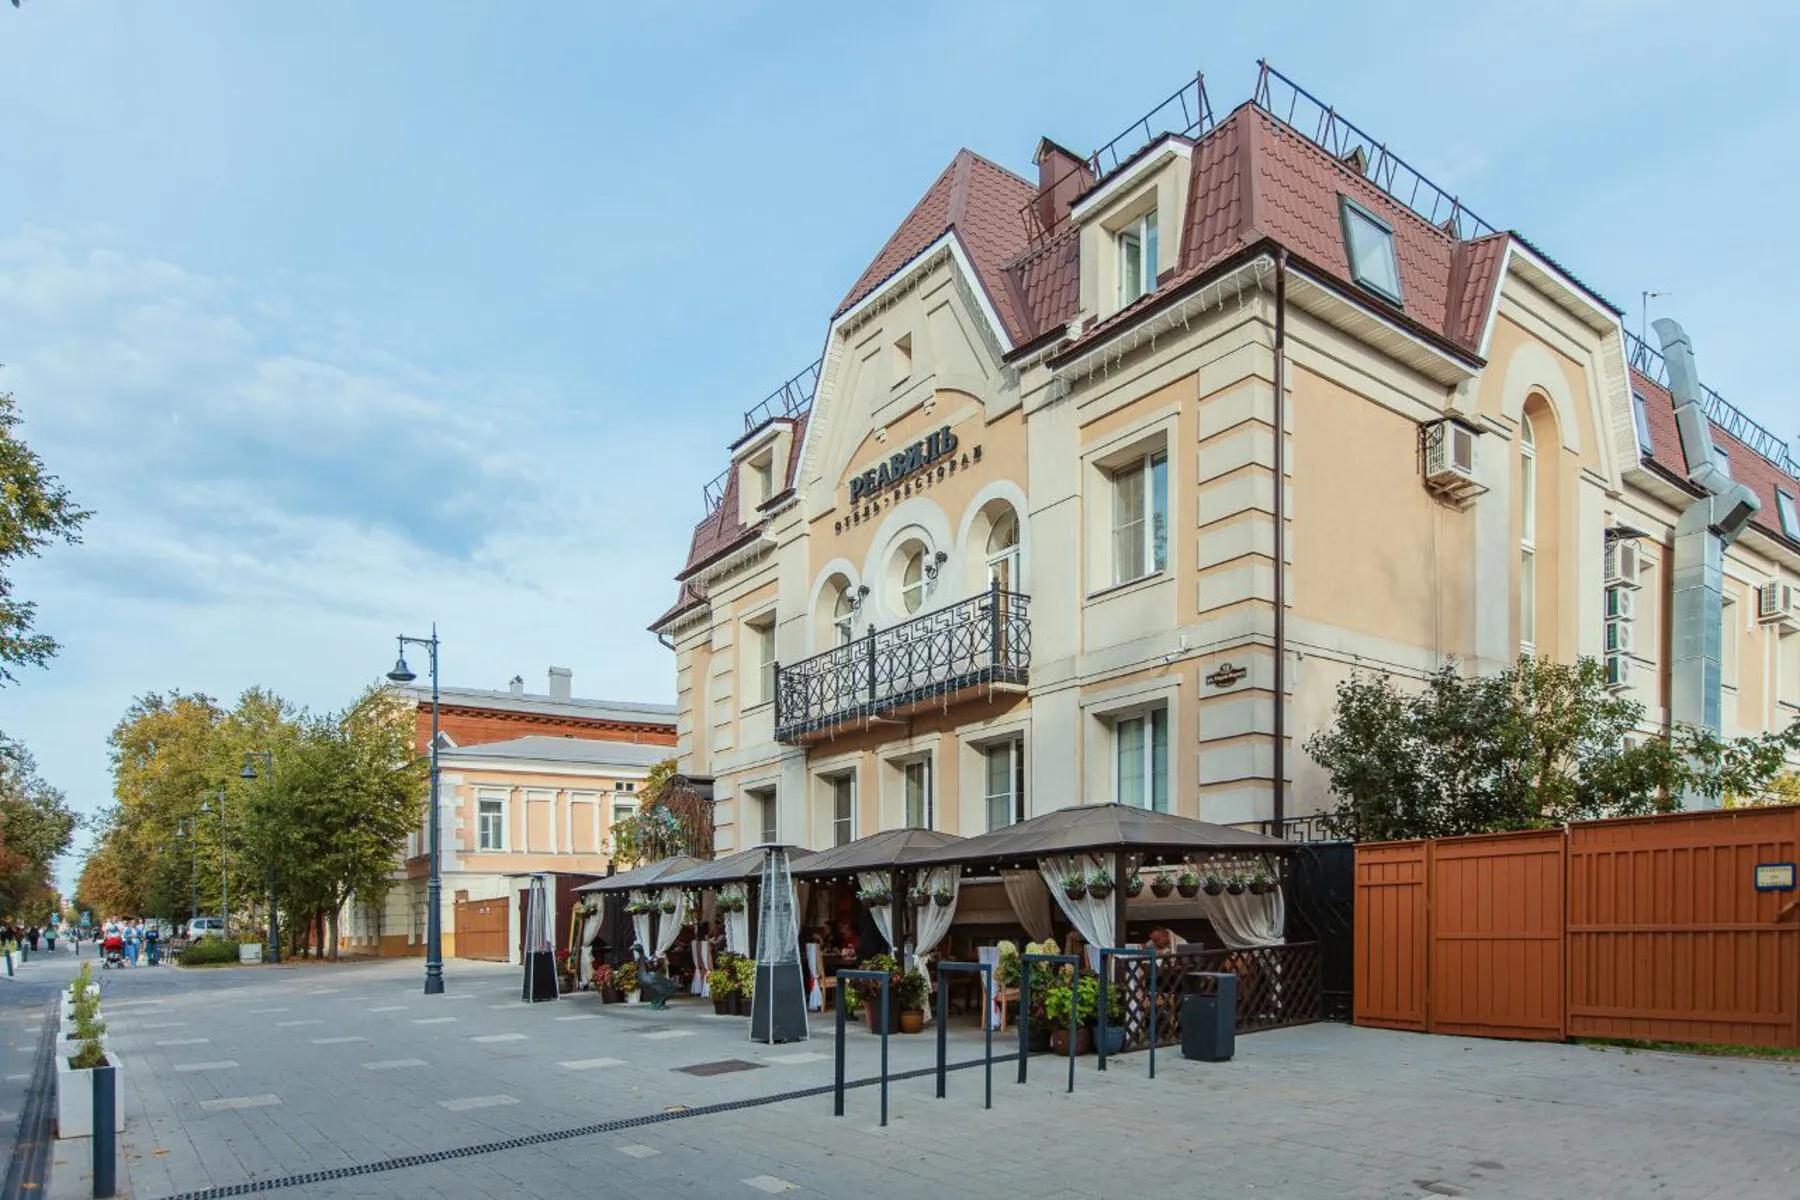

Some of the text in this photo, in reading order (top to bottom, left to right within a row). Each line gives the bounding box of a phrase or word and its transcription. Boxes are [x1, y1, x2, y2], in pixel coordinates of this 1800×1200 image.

[834, 445, 982, 532] ОТЕЛЬ РЕСТОРАН
[849, 425, 958, 504] РЕАВИЛЬ
